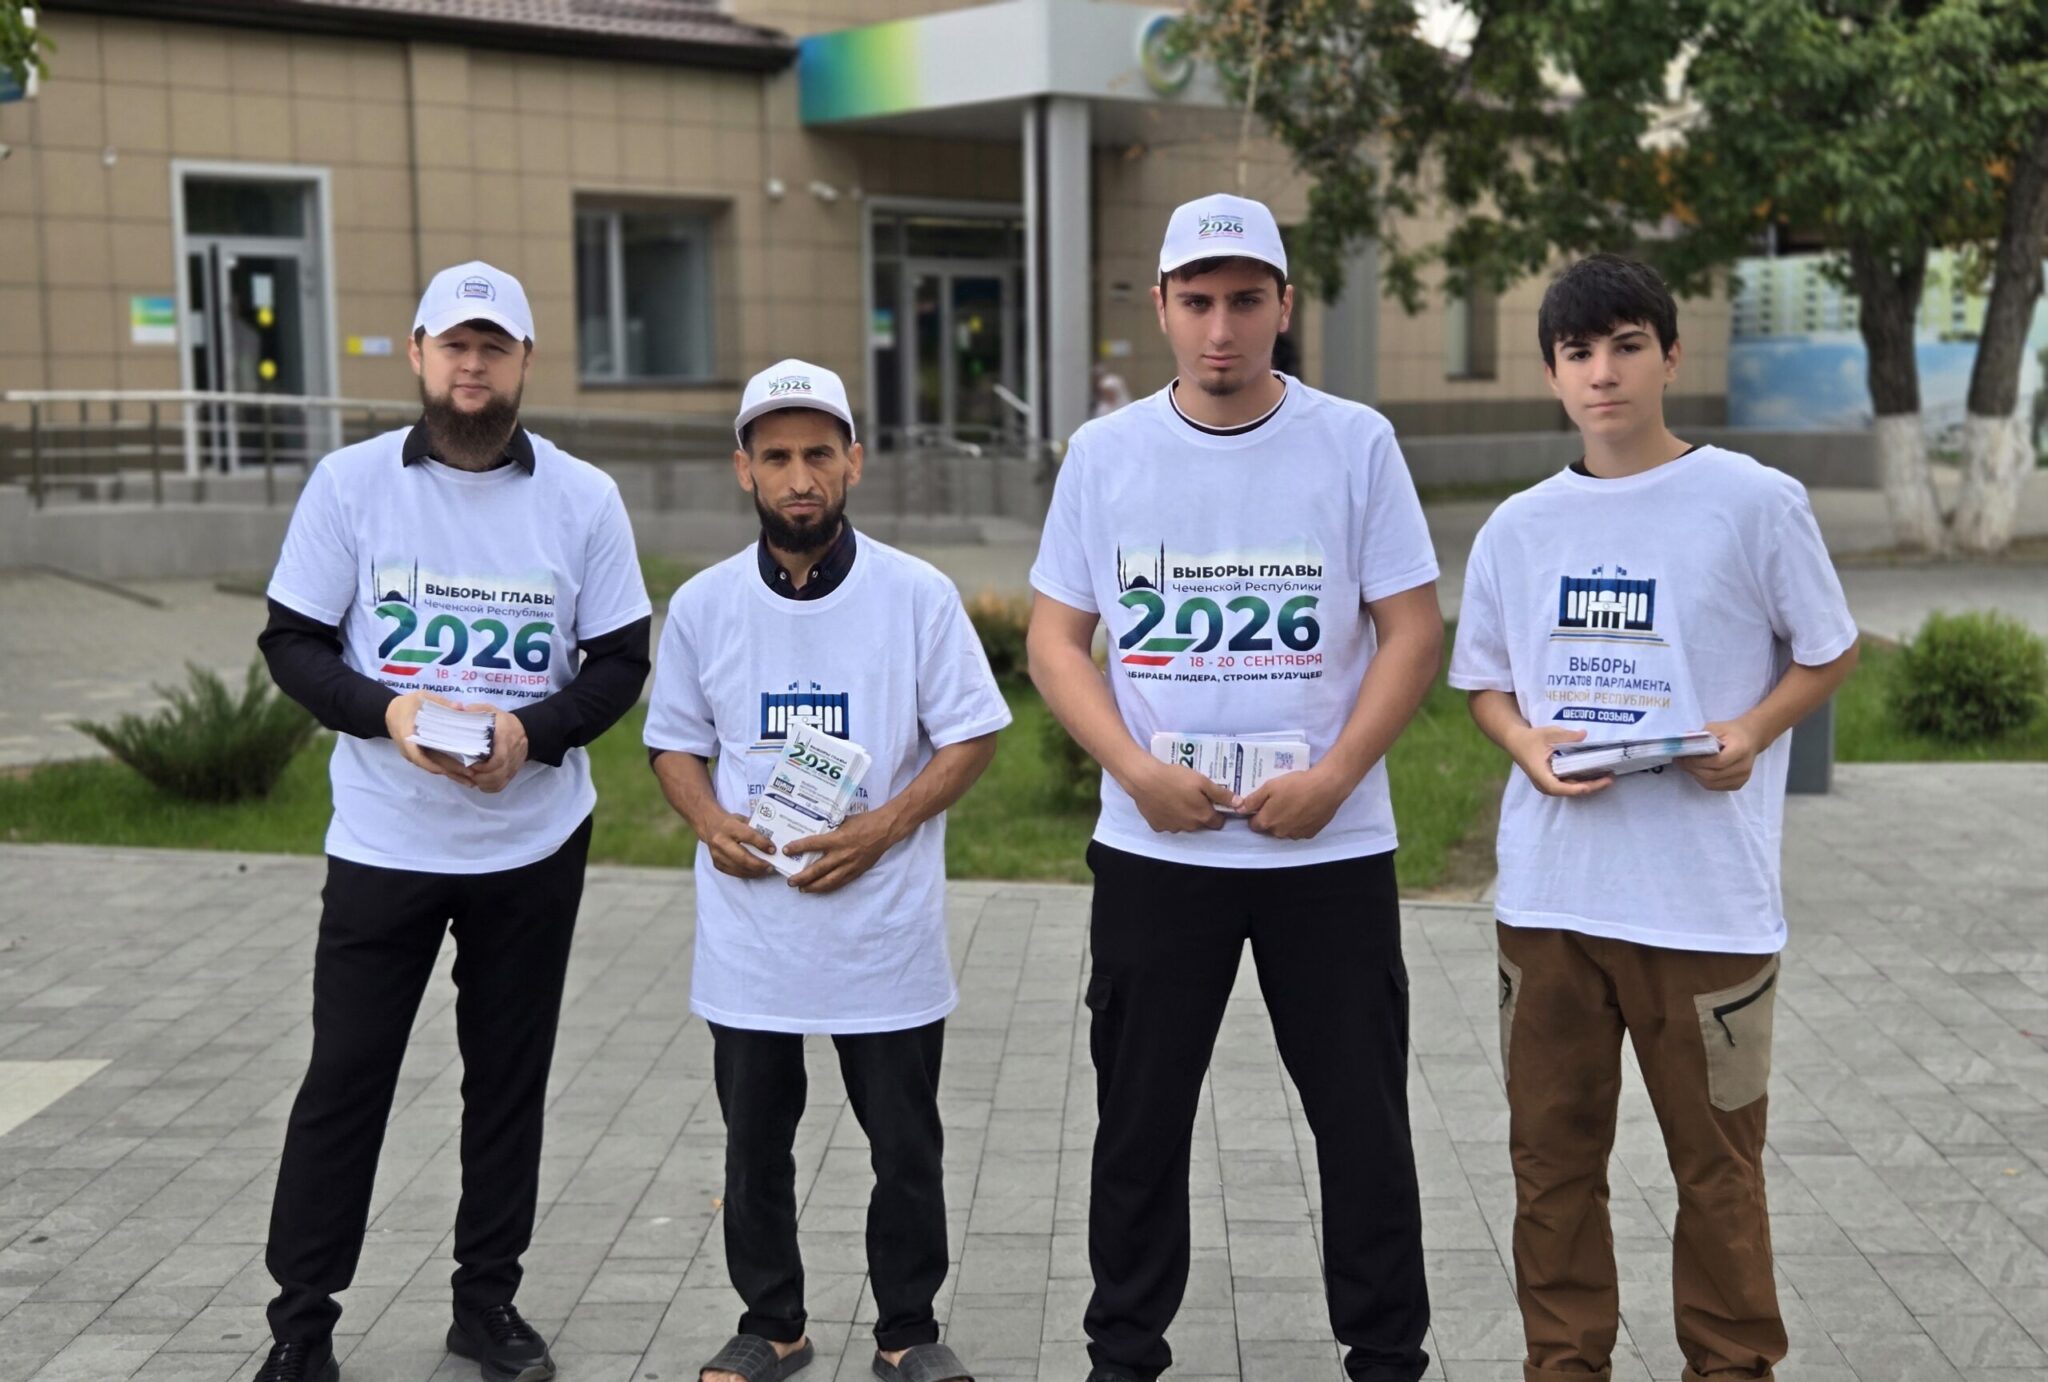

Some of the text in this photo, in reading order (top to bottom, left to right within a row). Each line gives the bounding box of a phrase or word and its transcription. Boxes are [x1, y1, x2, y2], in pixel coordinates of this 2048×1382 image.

[1199, 221, 1243, 234] 2026
[769, 381, 811, 394] 2026
[1173, 565, 1322, 578] ВЫБОРЫ ГЛАВЫ
[425, 584, 555, 606] ВЫБОРЫ ГЛАВЫ
[1172, 581, 1322, 594] Чеченской Республики
[424, 599, 484, 614] Чеченской
[1118, 590, 1321, 653] 2026
[373, 603, 555, 673] 2026
[1190, 656, 1204, 667] 18
[1217, 656, 1235, 668] 20
[1244, 653, 1322, 667] СЕНТЯБРЯ
[1569, 656, 1635, 674] ВЫБОРЫ
[436, 668, 449, 679] 18
[462, 670, 478, 681] 20
[1128, 671, 1172, 680] БИРАЕМ
[1175, 673, 1221, 683] ЛИДЕРА,
[1223, 673, 1268, 681] СТРОИМ
[422, 683, 464, 694] ЛИДЕРА,
[467, 686, 504, 696] СТРОИМ
[1595, 676, 1672, 693] ПАРЛАМЕНТА
[1594, 691, 1671, 709] РЕСПУБЛИКИ
[1597, 710, 1636, 723] СОЗЫВА
[789, 744, 843, 779] 2026
